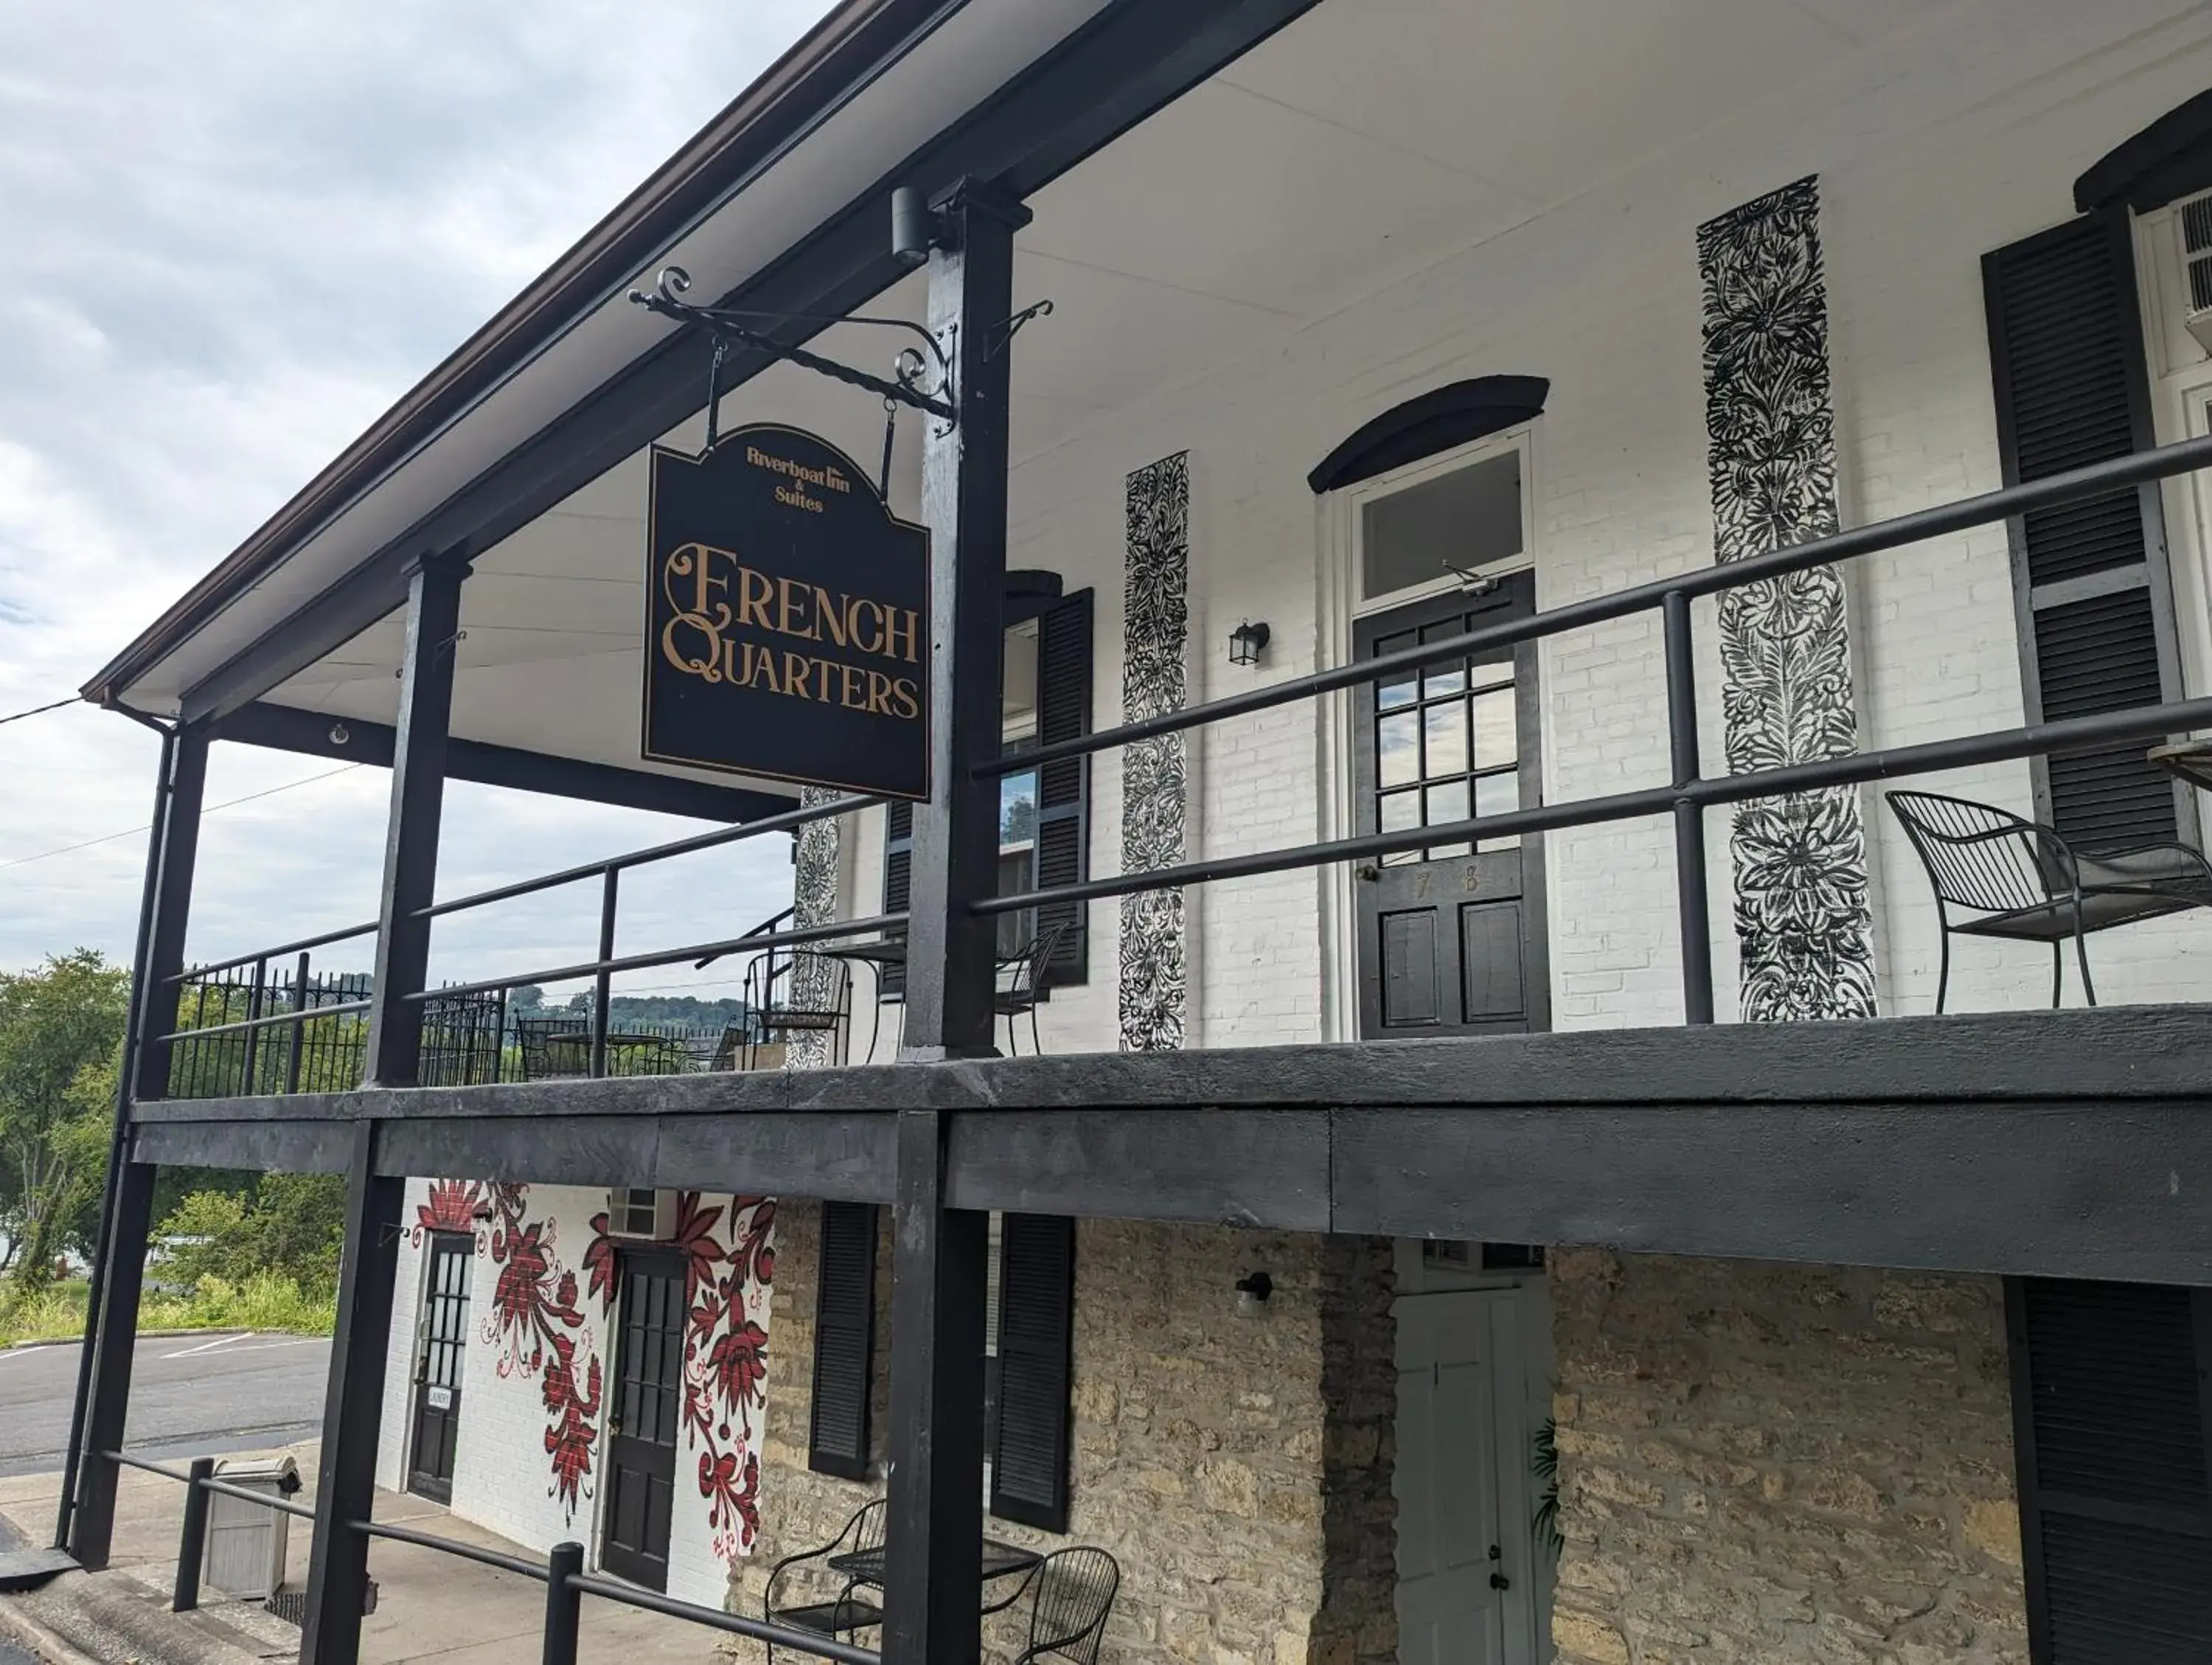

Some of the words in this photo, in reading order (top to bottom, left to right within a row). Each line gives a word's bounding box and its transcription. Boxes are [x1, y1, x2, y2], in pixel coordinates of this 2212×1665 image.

[747, 446, 824, 485] Riverboat
[826, 465, 850, 493] Inn
[796, 479, 804, 492] &
[775, 485, 824, 513] Suites
[664, 542, 919, 663] FRENCH
[662, 613, 919, 720] QUARTERS
